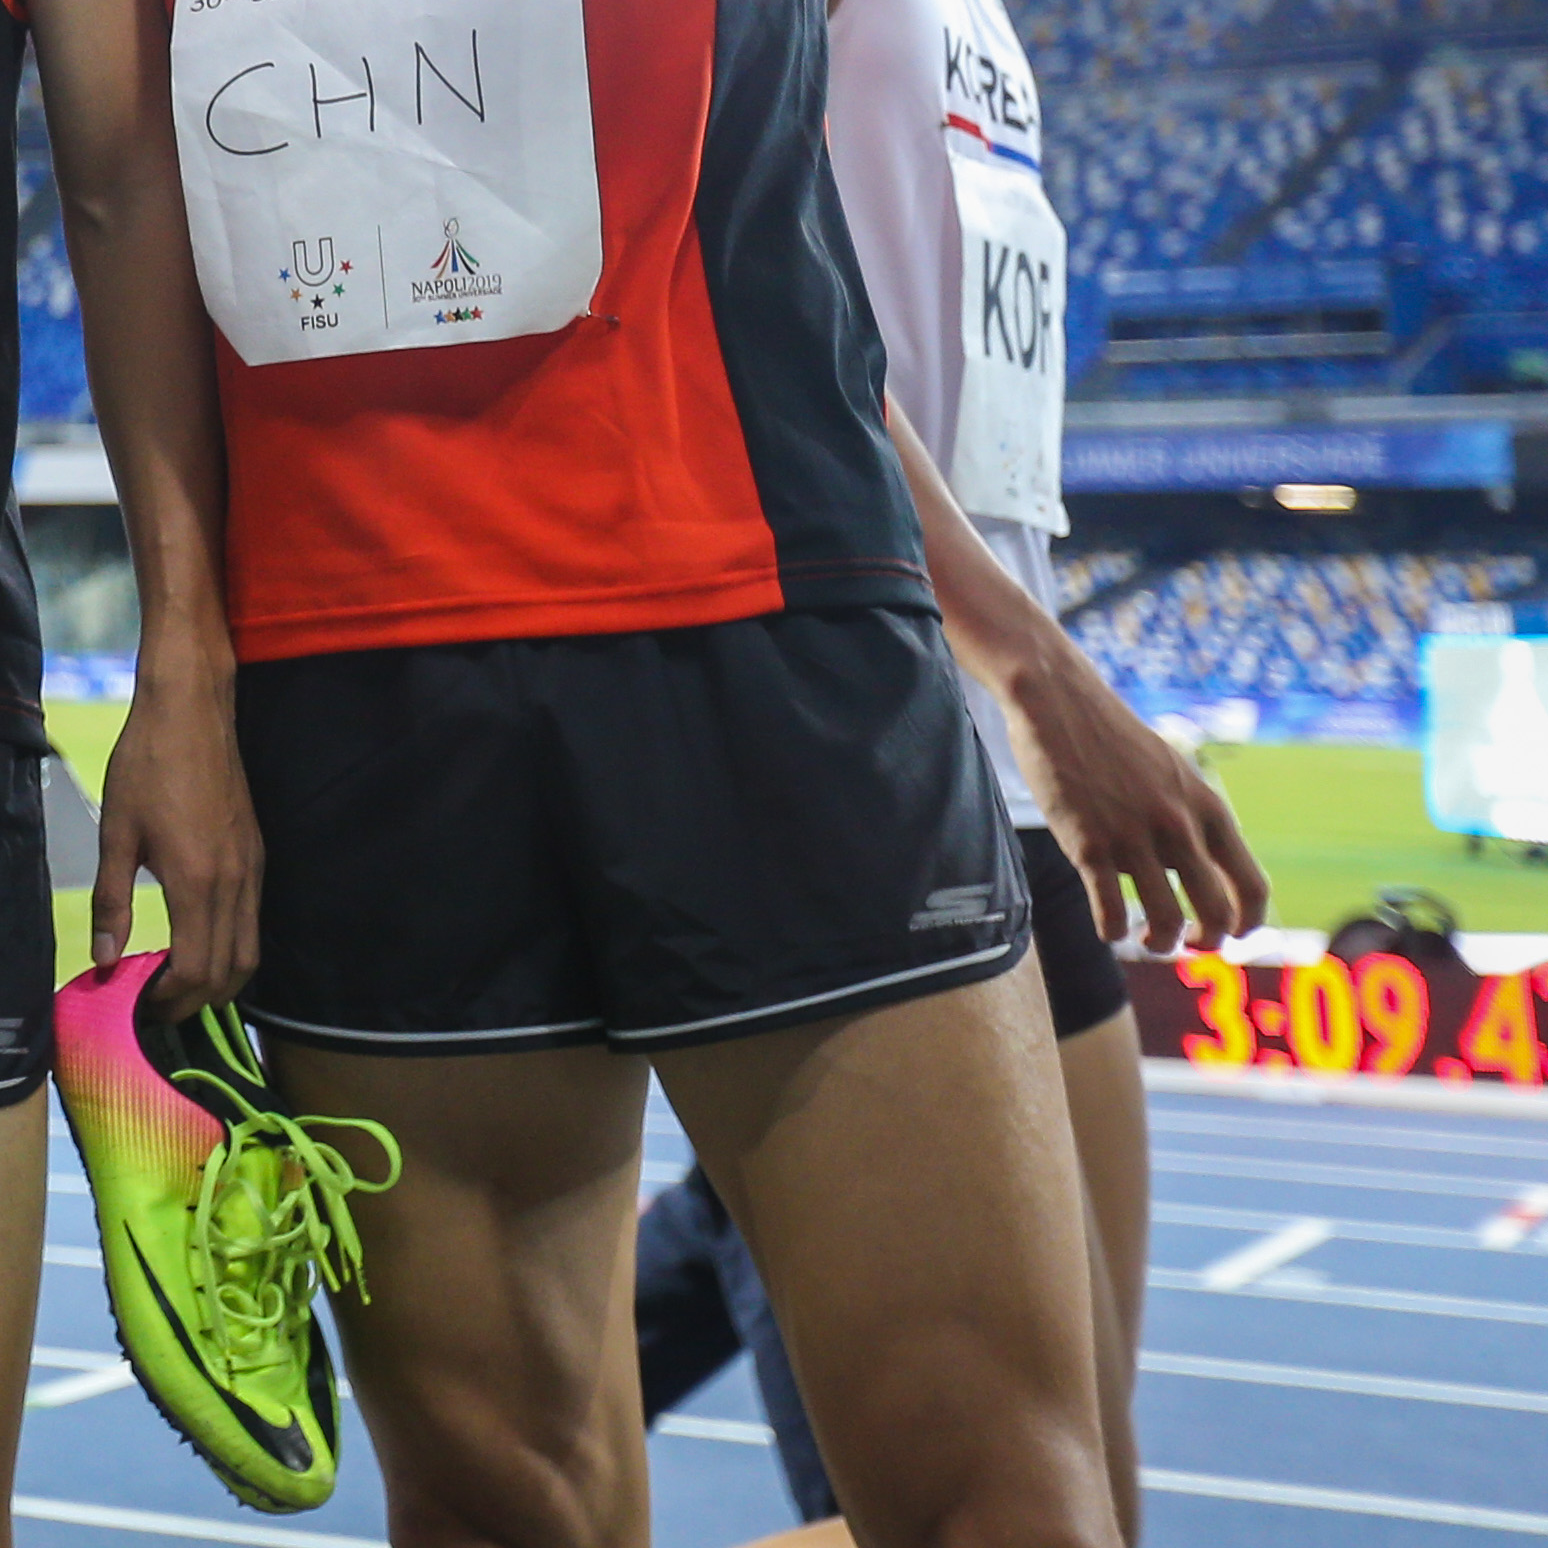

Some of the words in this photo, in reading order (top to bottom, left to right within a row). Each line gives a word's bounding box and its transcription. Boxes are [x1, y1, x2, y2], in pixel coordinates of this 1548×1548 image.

[206, 29, 485, 155] CHN
[944, 27, 1034, 133] KRE
[301, 313, 338, 331] FISU
[1176, 949, 1548, 1095] 3:09.4
